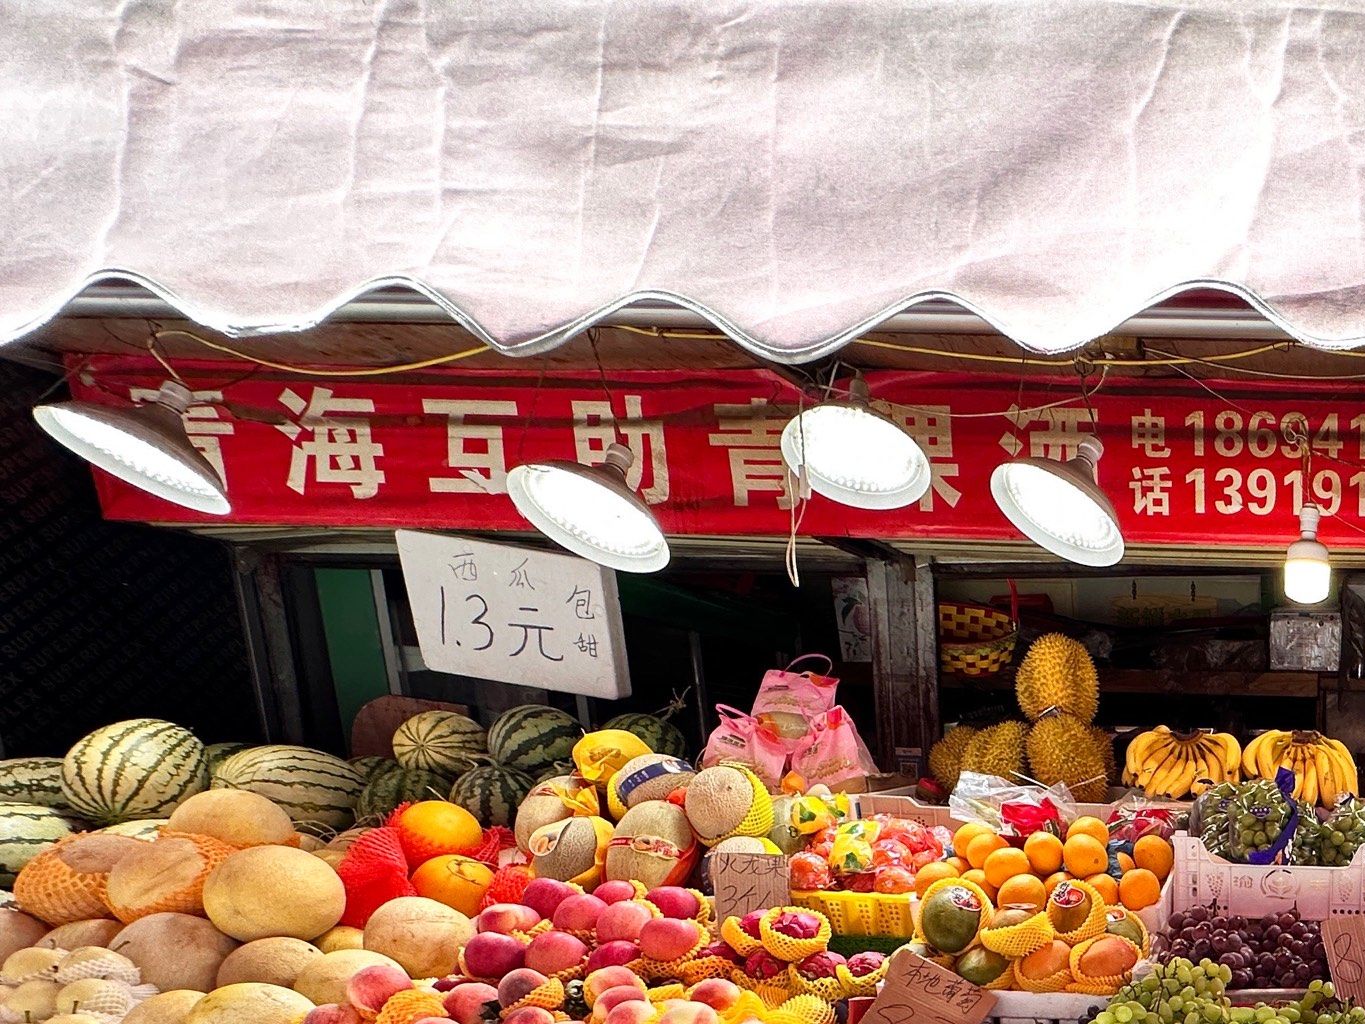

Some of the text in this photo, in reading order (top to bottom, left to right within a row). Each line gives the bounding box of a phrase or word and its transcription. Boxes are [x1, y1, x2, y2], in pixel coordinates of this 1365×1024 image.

[1130, 408, 1171, 459] 电
[1128, 466, 1172, 516] 话
[448, 553, 536, 592] 西瓜
[566, 585, 600, 659] 包甜
[902, 961, 983, 1012] 本地葡萄
